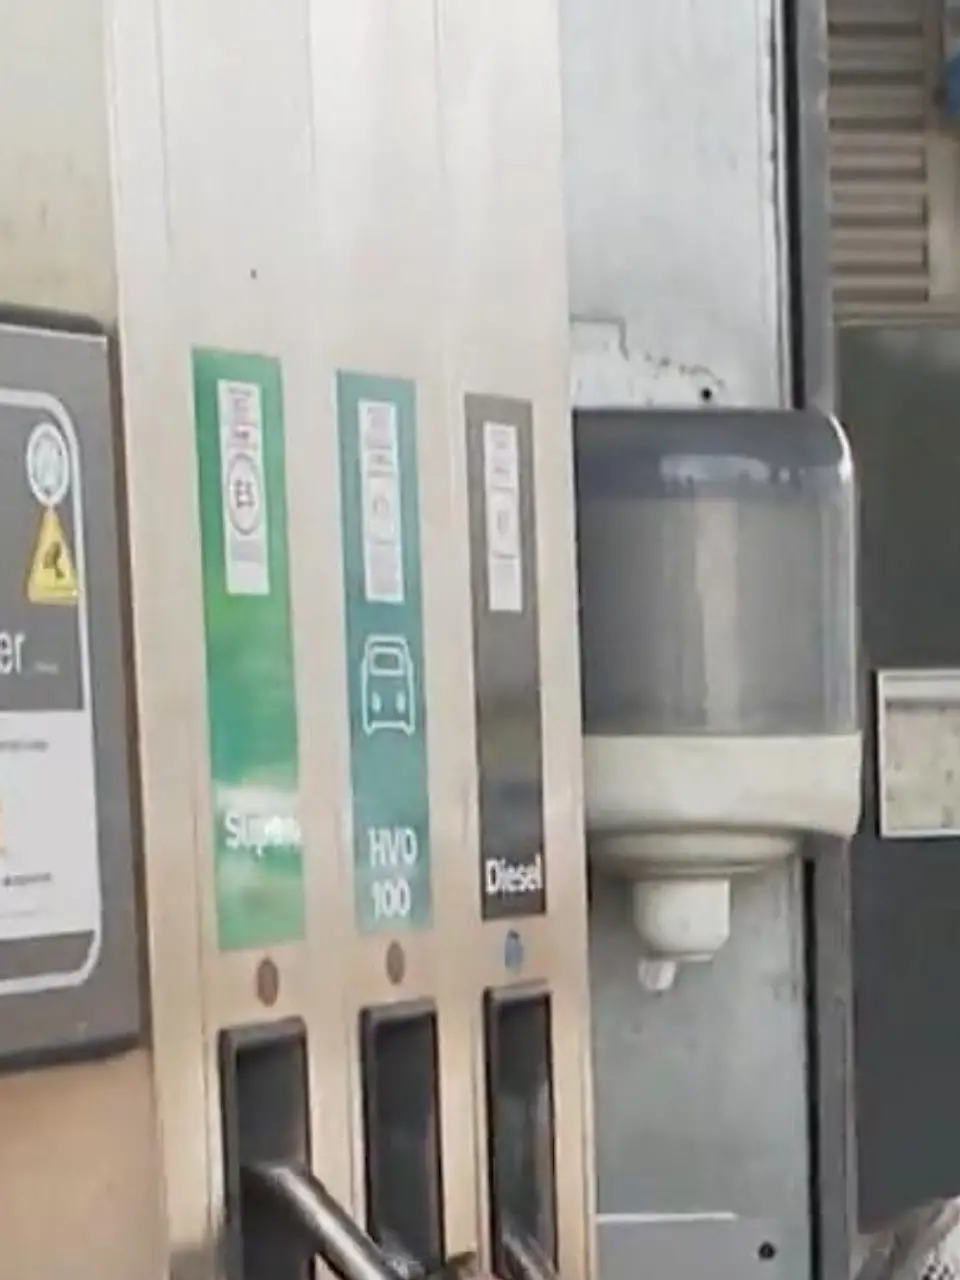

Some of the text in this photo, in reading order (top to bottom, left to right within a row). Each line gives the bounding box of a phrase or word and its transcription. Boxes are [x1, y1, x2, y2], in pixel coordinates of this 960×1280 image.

[224, 809, 303, 858] Sup
[368, 826, 419, 868] HVO
[485, 852, 542, 893] Diesel
[372, 875, 412, 920] 100
